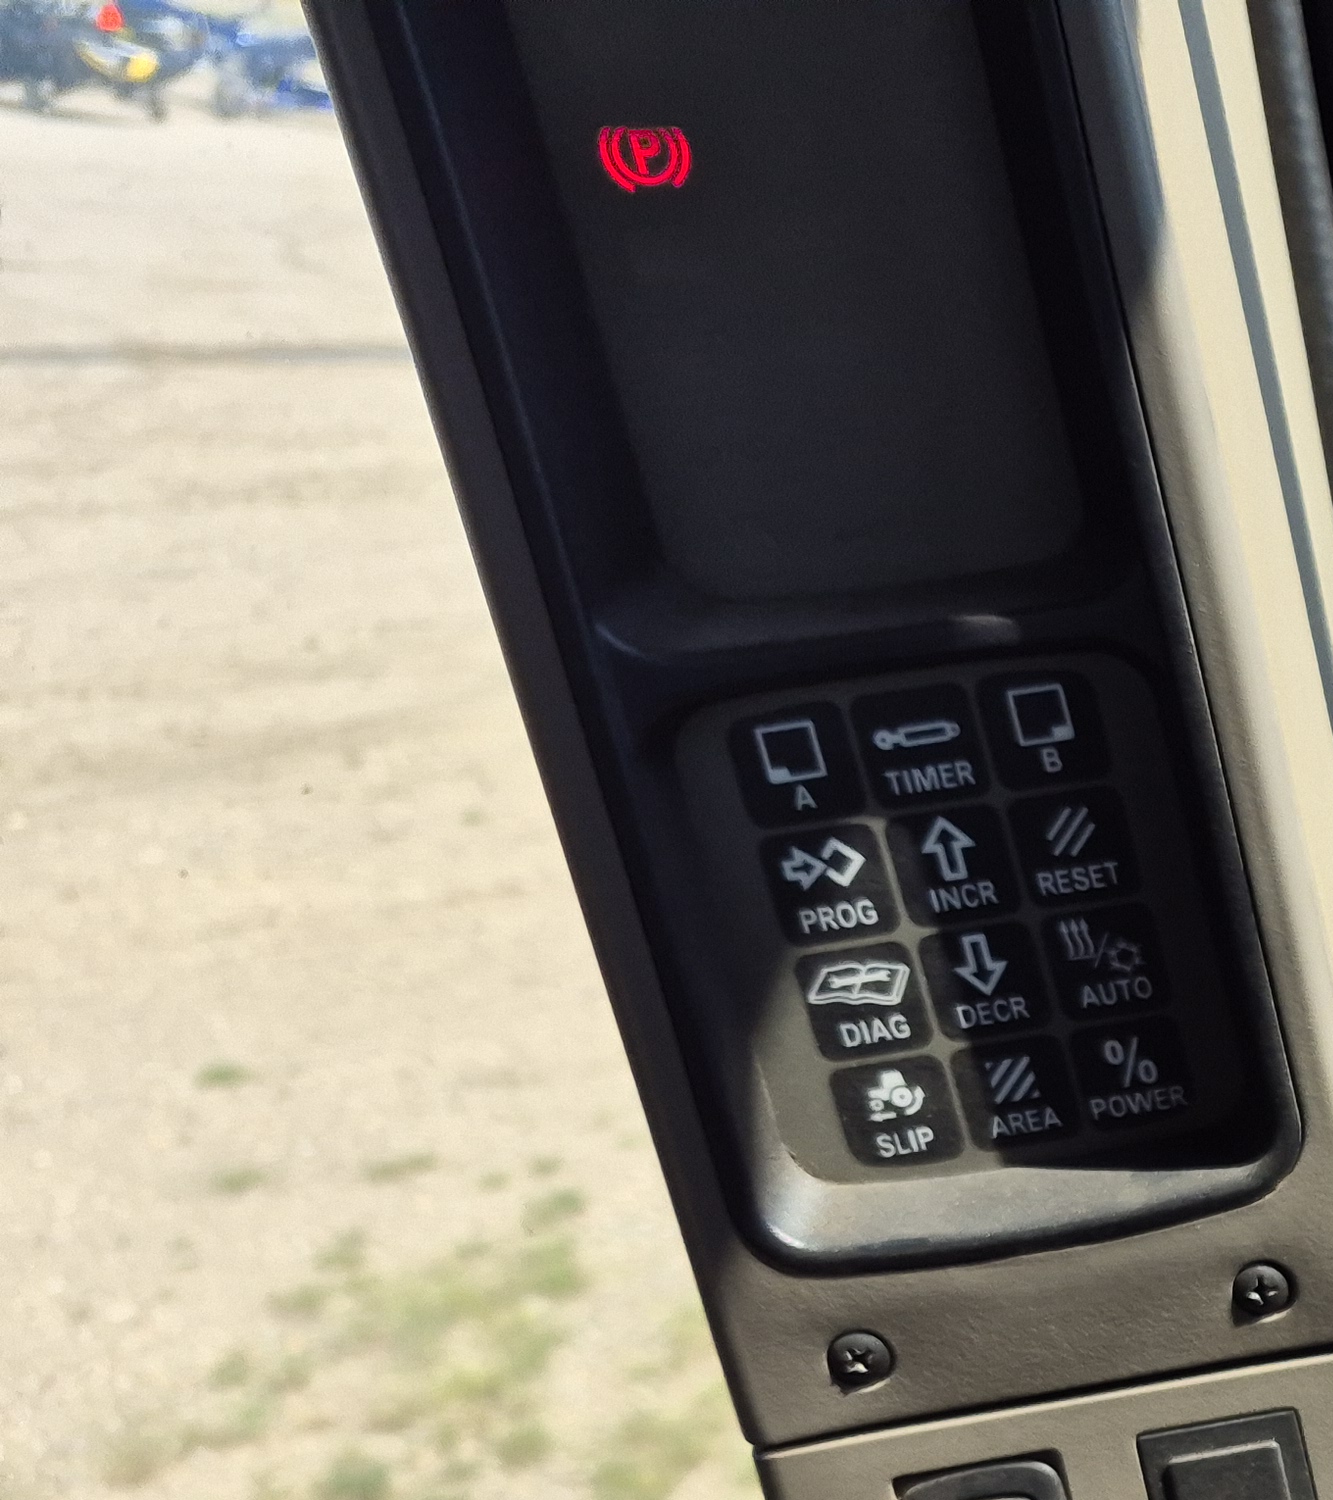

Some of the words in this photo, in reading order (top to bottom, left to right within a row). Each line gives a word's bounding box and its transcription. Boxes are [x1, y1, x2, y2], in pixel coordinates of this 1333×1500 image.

[1041, 748, 1061, 773] B
[885, 761, 976, 796] TIMER
[795, 785, 818, 811] A
[1036, 861, 1119, 896] RESET
[930, 881, 998, 913] INCR
[799, 899, 879, 933] PROG
[1081, 976, 1153, 1008] AUTO
[955, 997, 1029, 1029] DECR
[839, 1014, 912, 1048] DIAG
[1088, 1085, 1187, 1120] POWER
[992, 1107, 1063, 1139] AREA
[876, 1126, 935, 1159] SLIP
